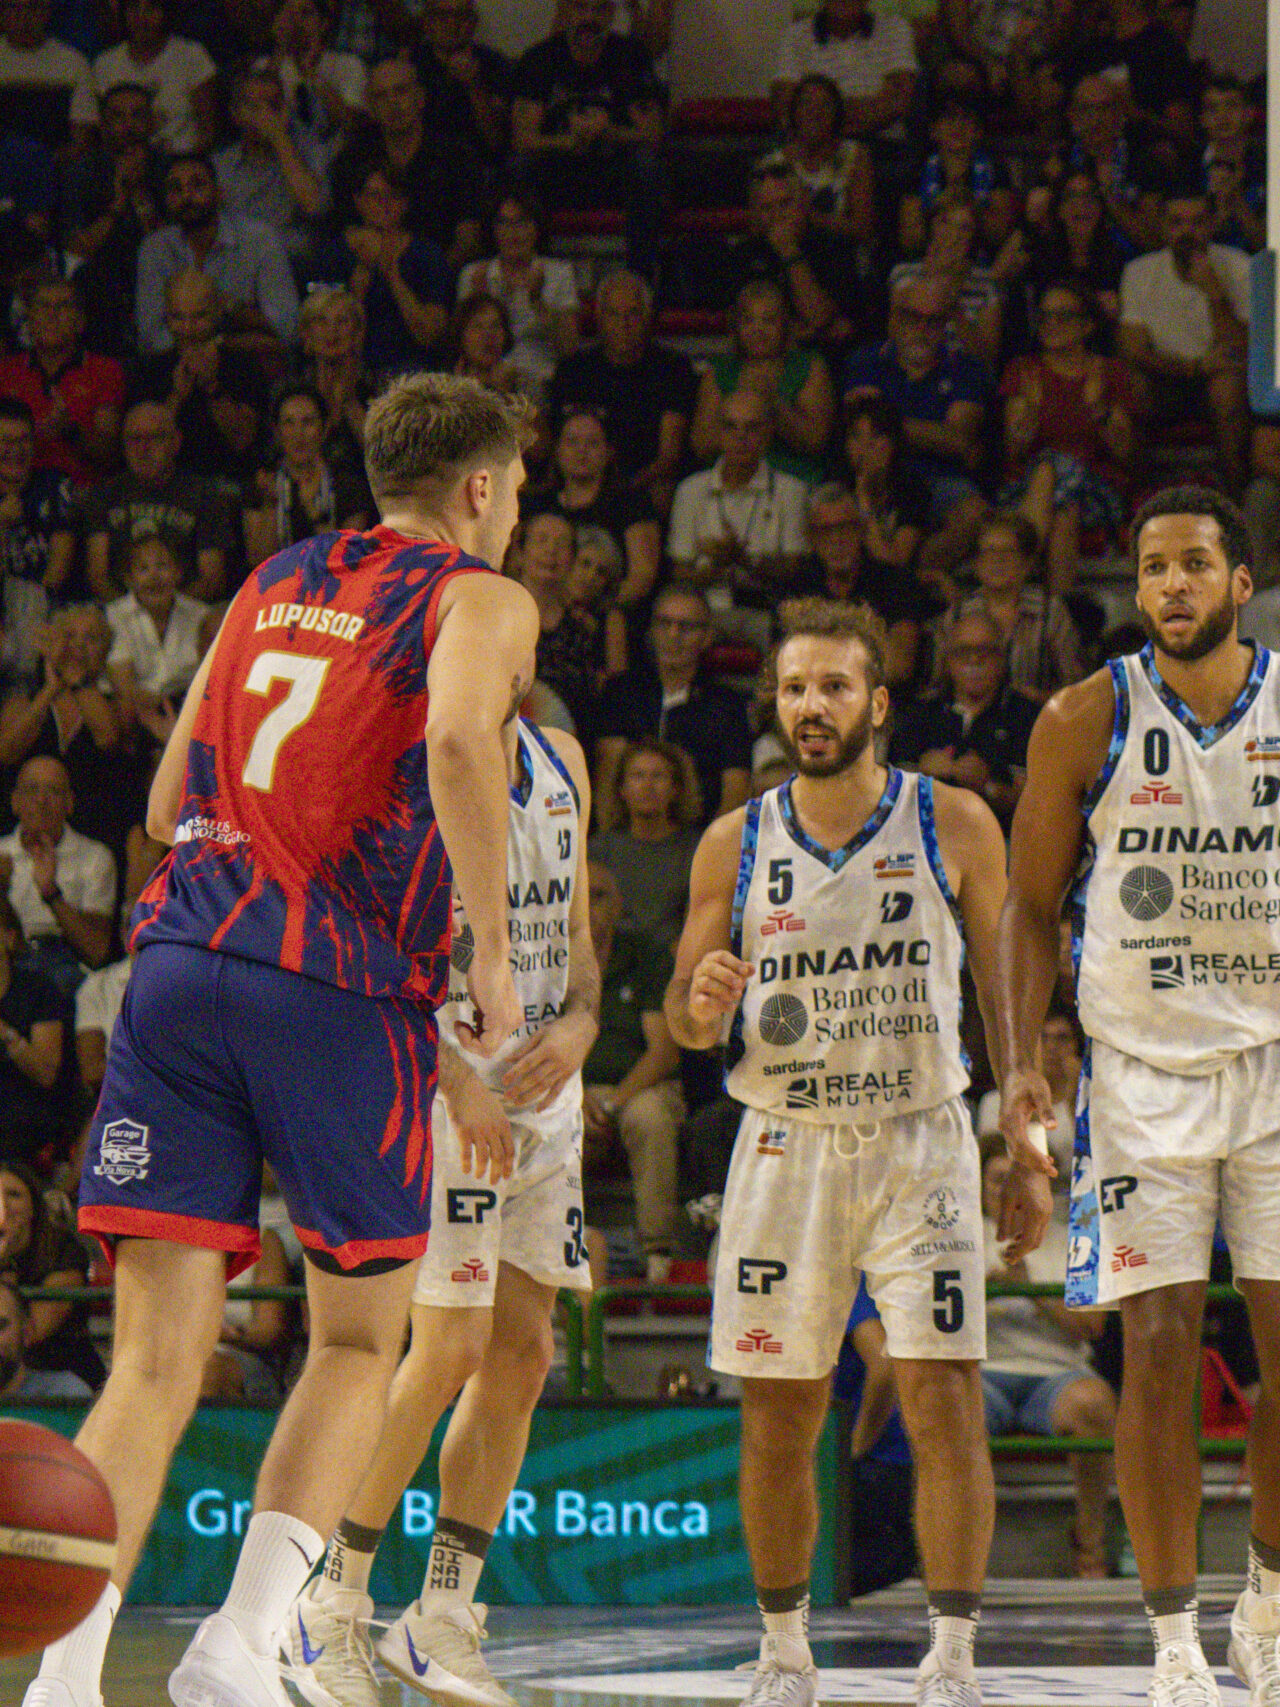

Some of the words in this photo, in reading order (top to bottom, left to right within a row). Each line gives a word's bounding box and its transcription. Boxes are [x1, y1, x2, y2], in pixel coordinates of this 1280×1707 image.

[254, 603, 365, 643] LUPUSOR
[242, 649, 333, 794] 7
[1144, 727, 1170, 776] 0
[192, 825, 250, 845] NOLEGGIO
[195, 815, 231, 833] SALUS
[507, 876, 571, 909] NAM
[768, 858, 794, 905] 5
[1181, 864, 1268, 890] Banco
[508, 944, 569, 974] Sarde
[1120, 936, 1192, 950] sardares
[760, 939, 931, 984] DINAMO
[812, 983, 897, 1012] Banco
[903, 978, 928, 1002] di
[815, 1012, 940, 1043] Sardegna
[763, 1059, 826, 1076] sardares
[825, 1069, 913, 1093] REALE
[827, 1087, 912, 1107] MUTUA
[108, 1128, 140, 1140] Garage
[447, 1188, 497, 1223] EP
[737, 1257, 788, 1295] EP
[932, 1269, 964, 1334] 5
[555, 1489, 710, 1537] Banca
